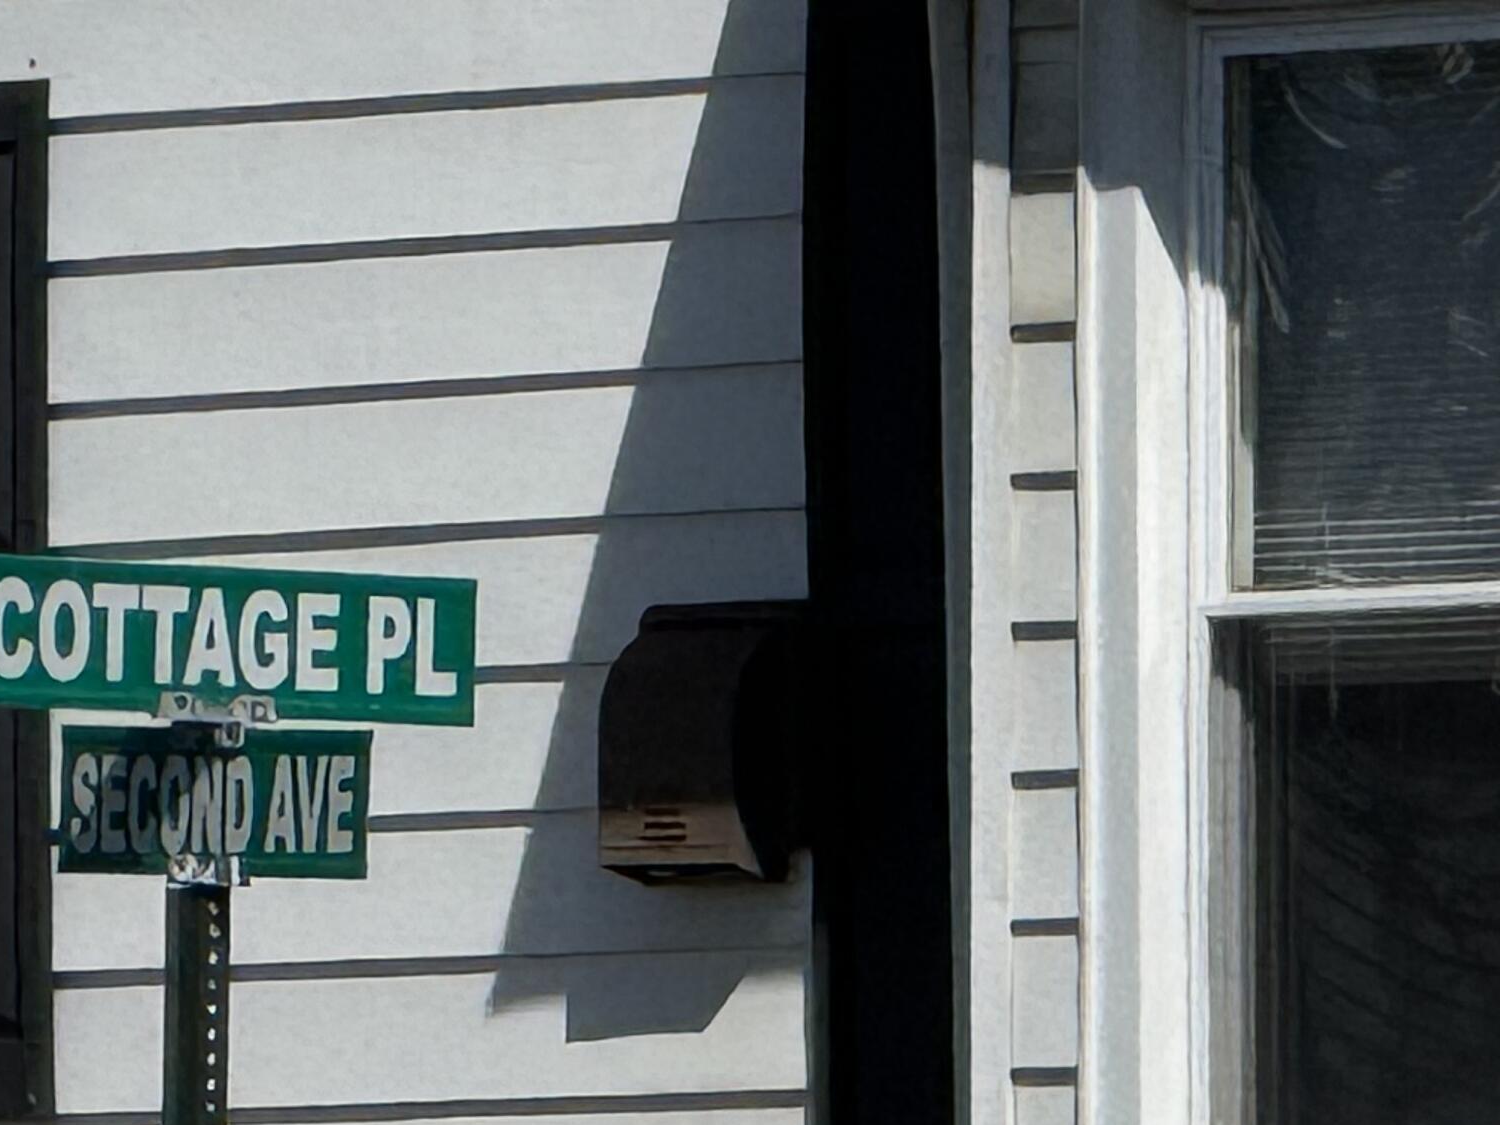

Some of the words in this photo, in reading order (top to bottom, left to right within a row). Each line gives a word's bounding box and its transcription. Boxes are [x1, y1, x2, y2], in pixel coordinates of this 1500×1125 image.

[366, 595, 458, 697] PL
[71, 752, 254, 855] SECOND
[264, 754, 355, 854] AVE
